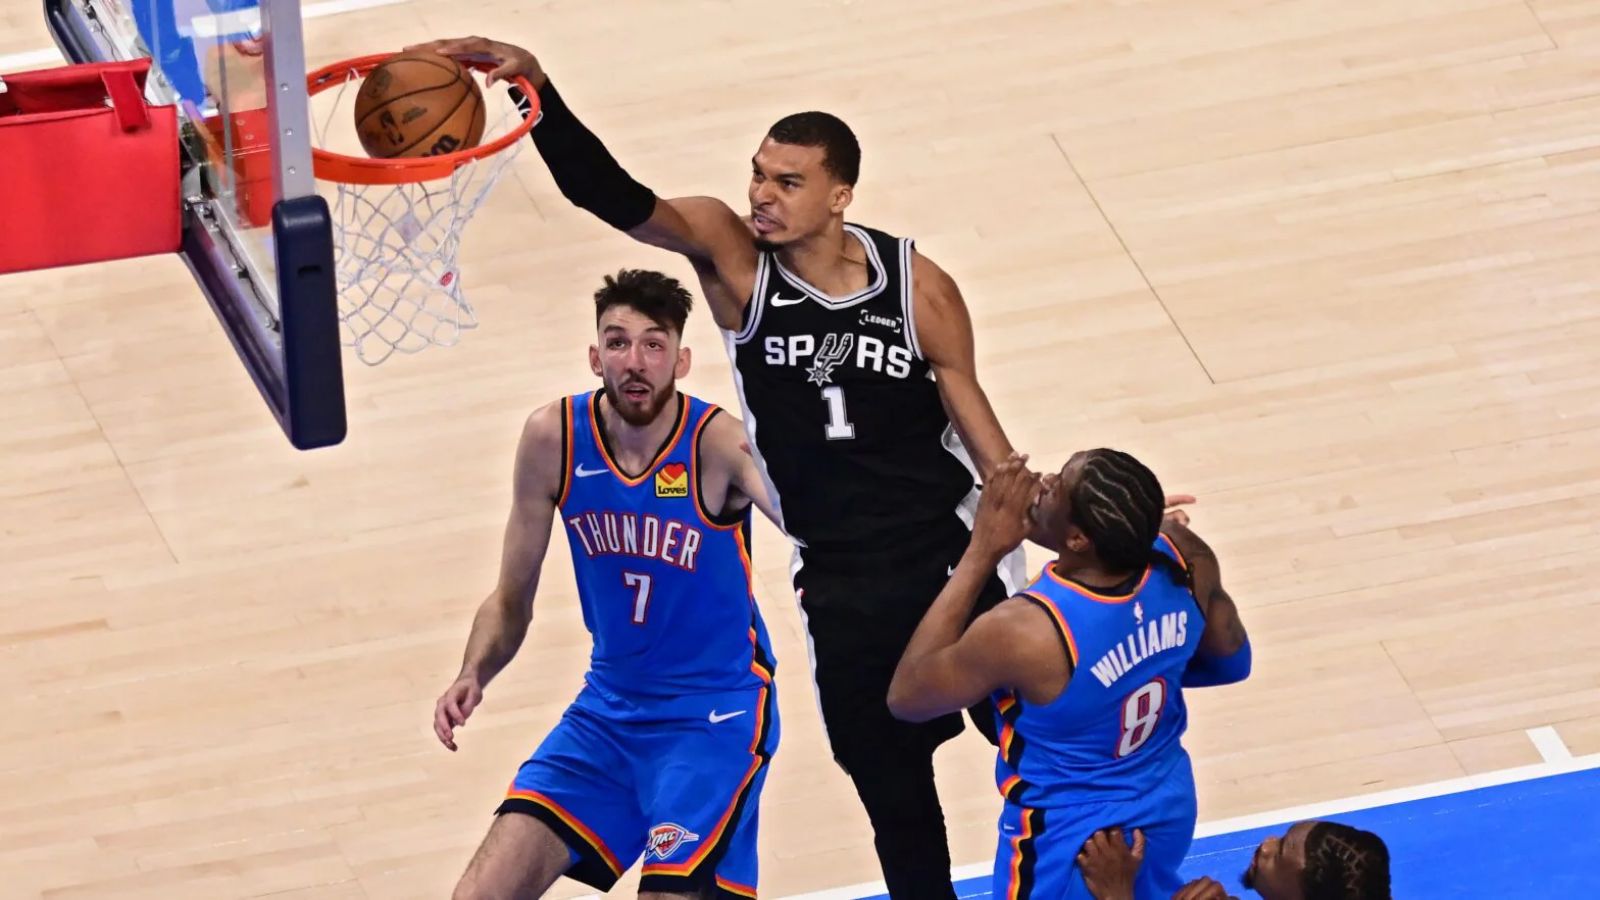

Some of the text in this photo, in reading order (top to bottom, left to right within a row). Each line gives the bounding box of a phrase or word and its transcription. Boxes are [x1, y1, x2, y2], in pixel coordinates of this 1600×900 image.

[865, 314, 897, 328] LEDGER
[821, 386, 855, 440] 1
[568, 511, 702, 572] THUNDER
[622, 570, 652, 625] 7
[1090, 610, 1188, 688] WILLIAMS
[1115, 676, 1168, 760] 8
